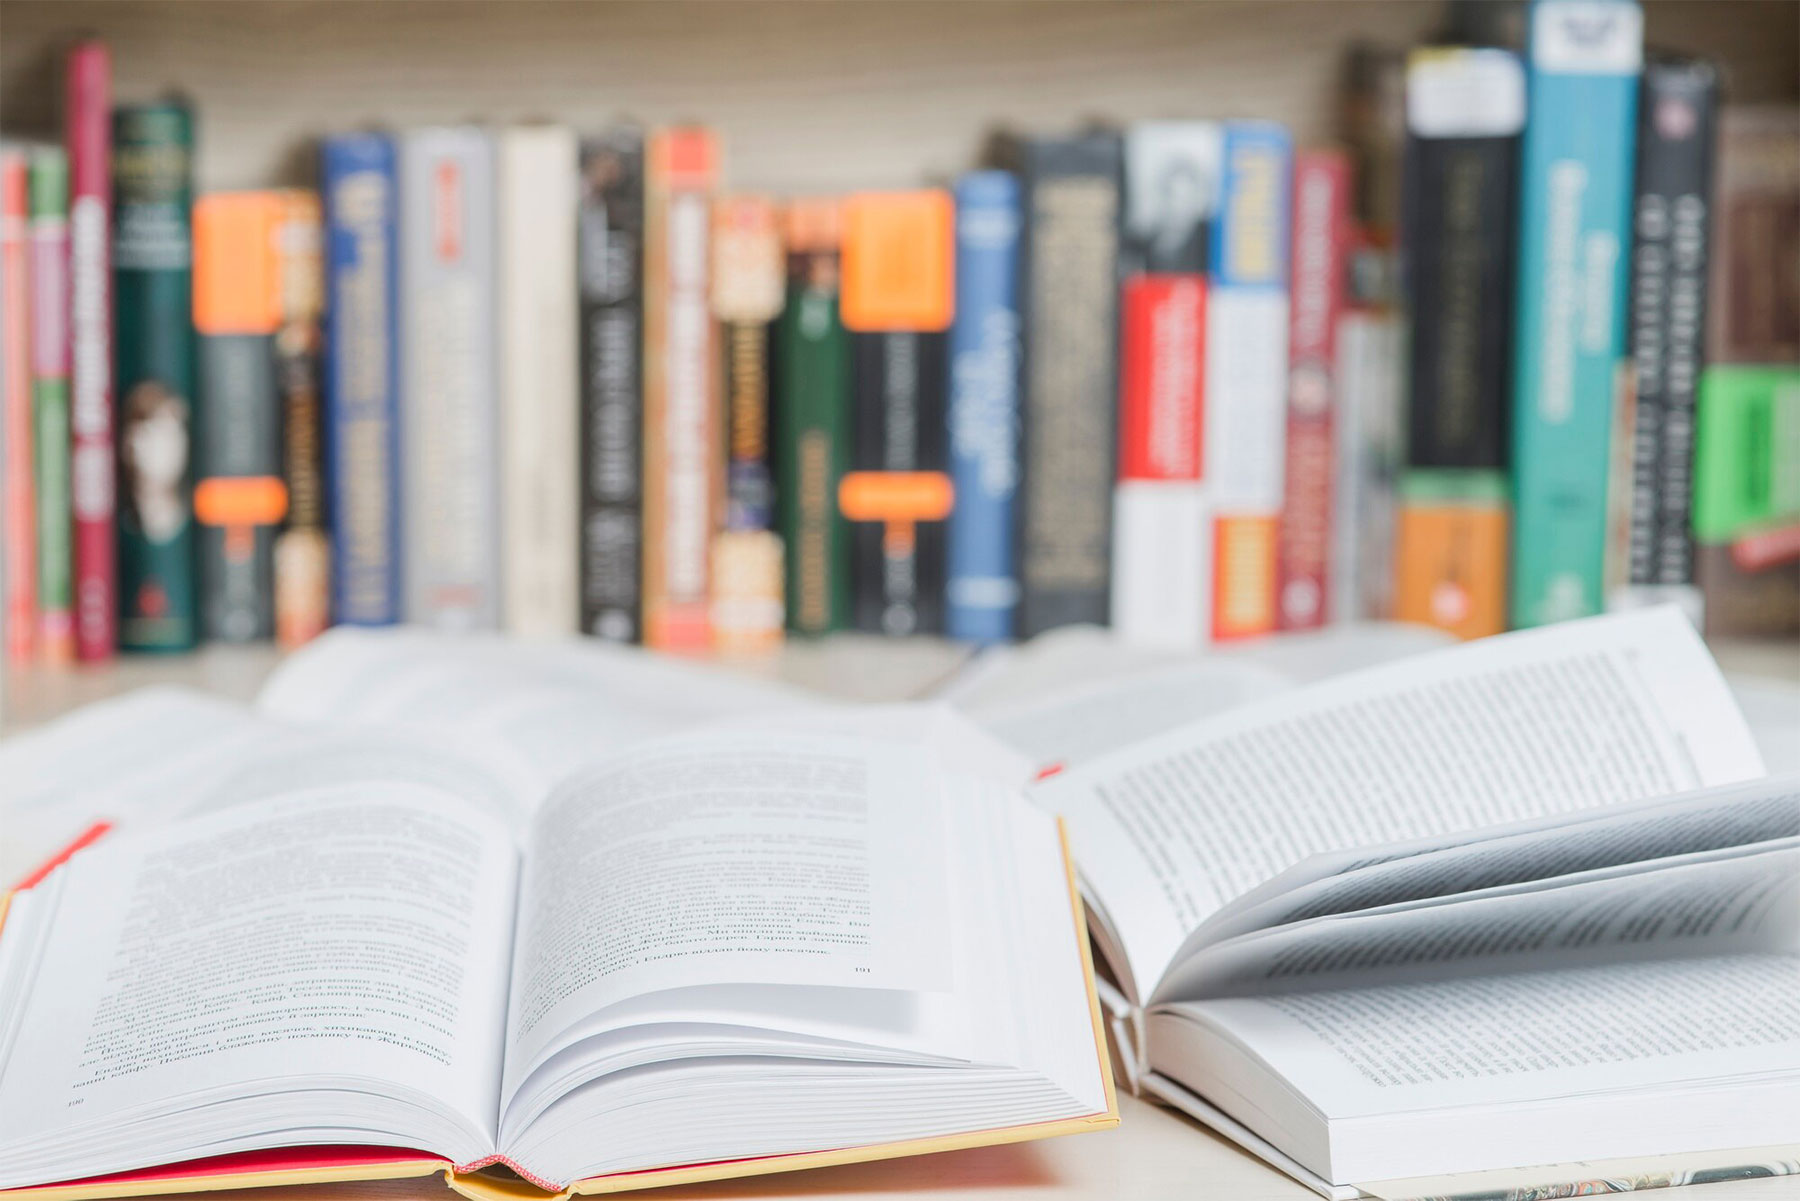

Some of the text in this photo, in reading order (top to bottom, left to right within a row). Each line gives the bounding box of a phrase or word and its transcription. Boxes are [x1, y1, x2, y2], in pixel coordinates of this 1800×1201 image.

[643, 951, 688, 962] Ендрю
[691, 947, 733, 955] віддав
[854, 966, 871, 974] 191
[192, 1016, 238, 1032] раптом
[222, 1015, 285, 1032] рівновагу
[93, 1061, 138, 1076] Ендрю
[141, 1043, 209, 1063] нахилився
[225, 1033, 255, 1043] взяв
[323, 1025, 397, 1037] хихикаючи
[158, 1048, 214, 1065] Побачив
[217, 1036, 282, 1051] блаженну
